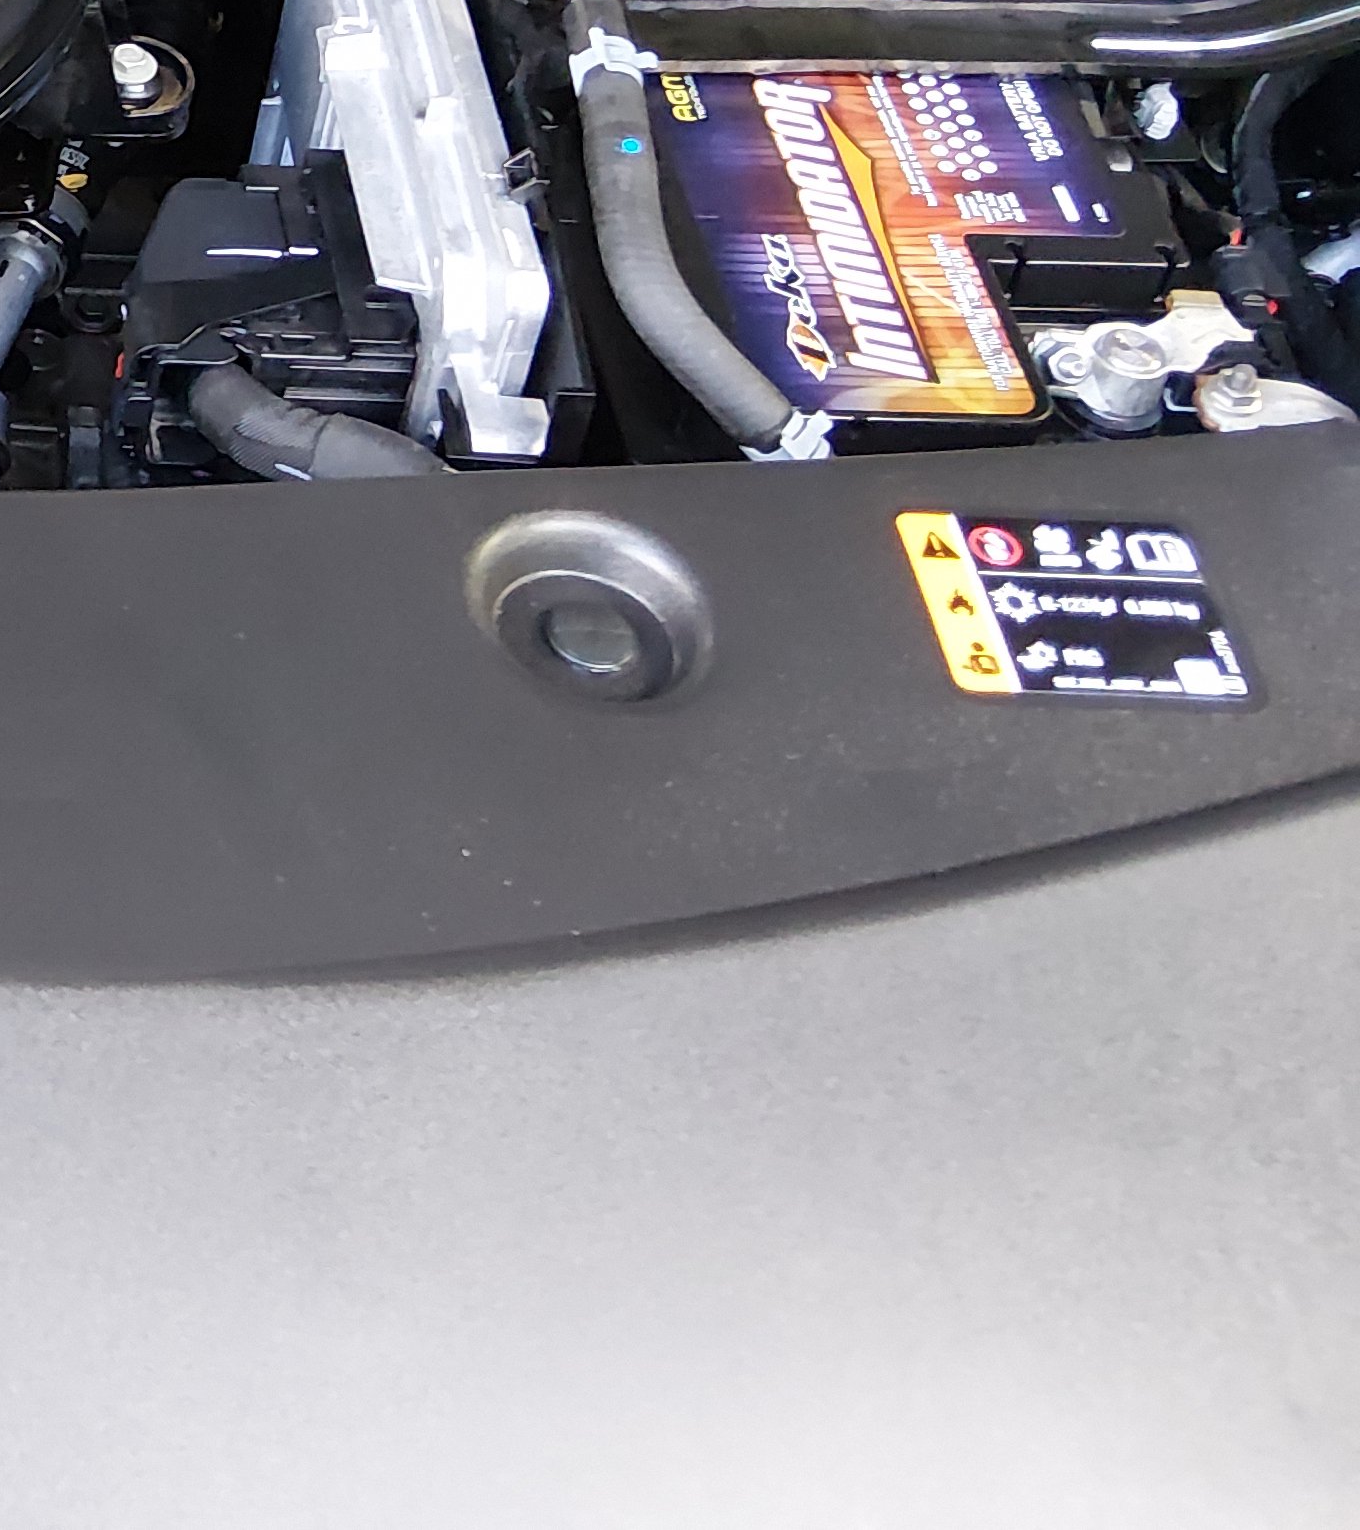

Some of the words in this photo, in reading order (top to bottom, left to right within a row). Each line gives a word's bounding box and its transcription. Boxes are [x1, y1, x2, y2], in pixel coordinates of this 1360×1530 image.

[999, 82, 1031, 130] BATTERY
[1032, 115, 1054, 137] NOT
[1043, 140, 1064, 157] DO
